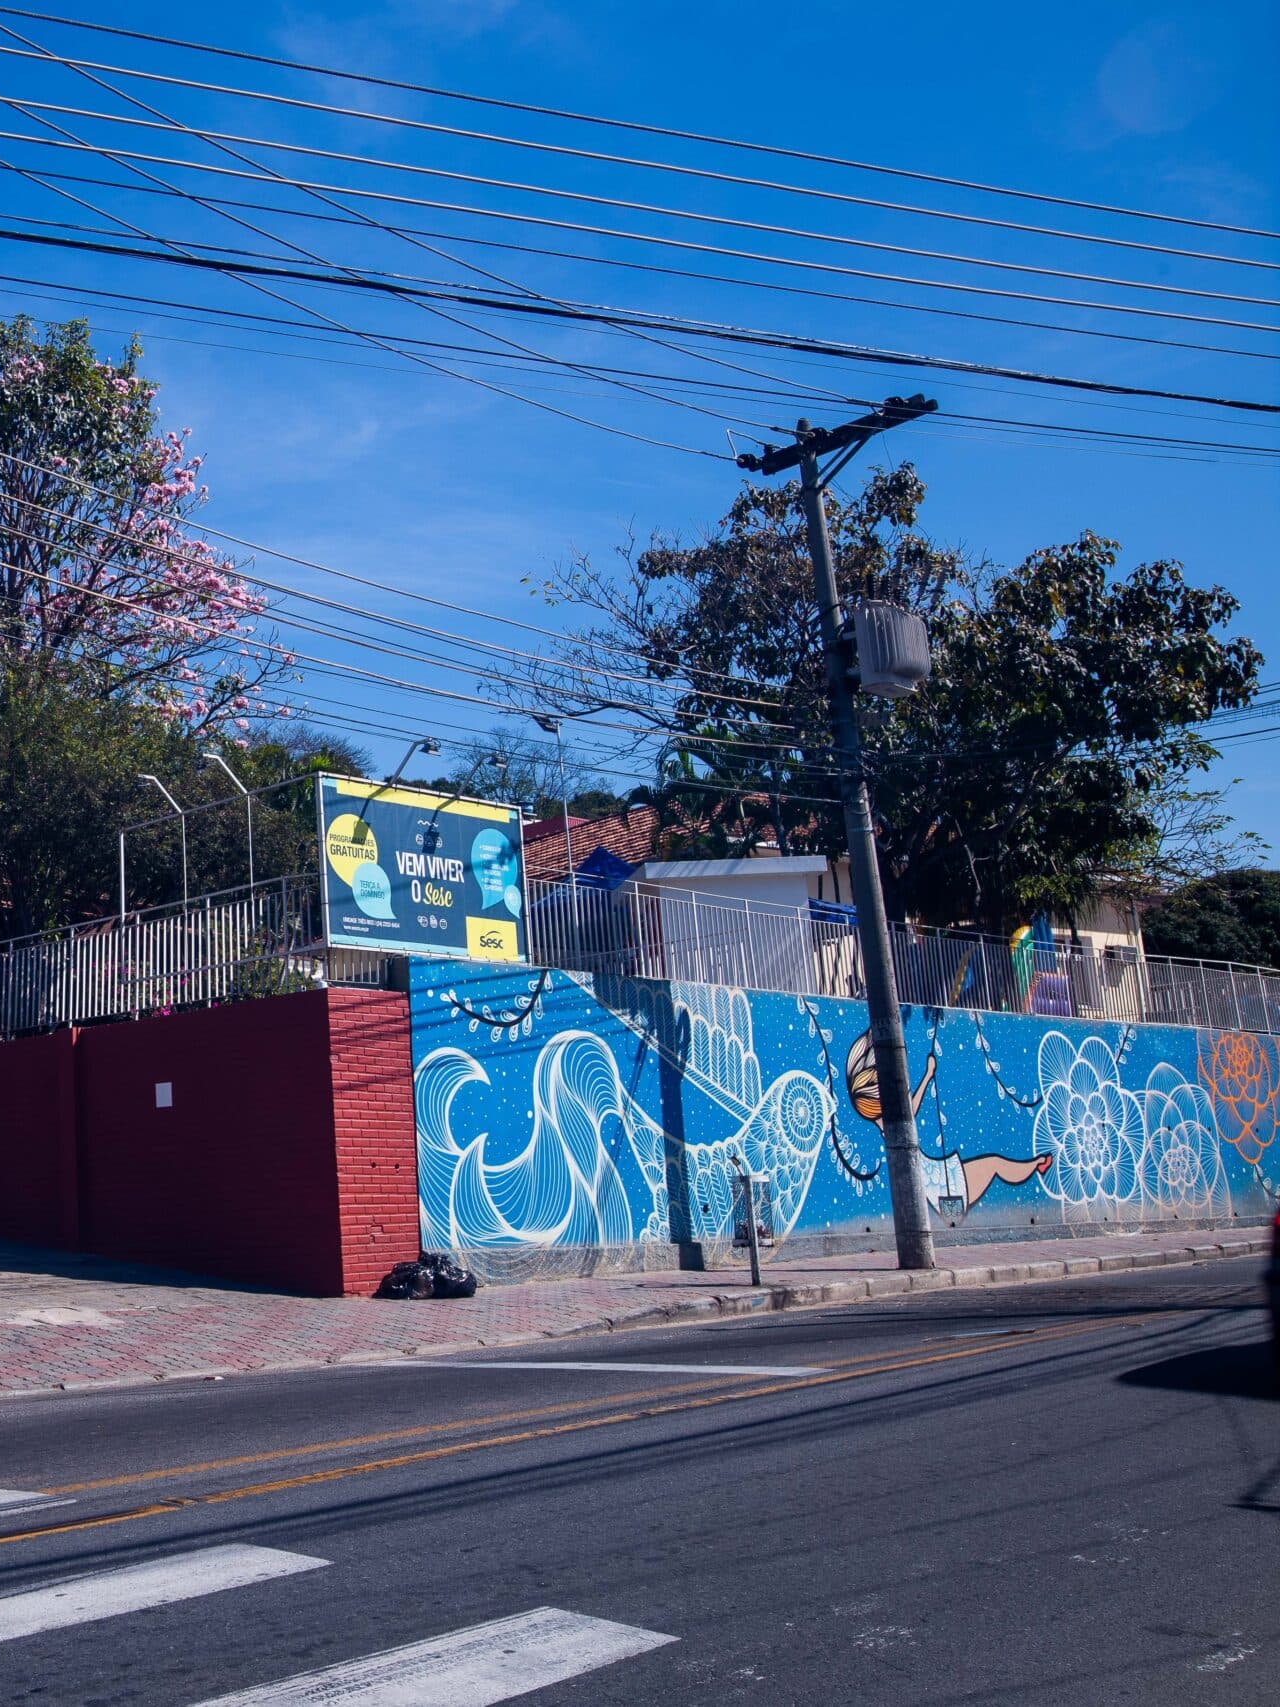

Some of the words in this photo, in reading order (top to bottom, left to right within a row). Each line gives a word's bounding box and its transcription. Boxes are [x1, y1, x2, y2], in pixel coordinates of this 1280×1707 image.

[330, 844, 376, 861] GRATUITAS
[395, 850, 426, 878] VEM
[427, 855, 465, 884] VIVER
[411, 879, 422, 904] O
[423, 881, 454, 908] Sesc
[480, 935, 504, 949] Sesc
